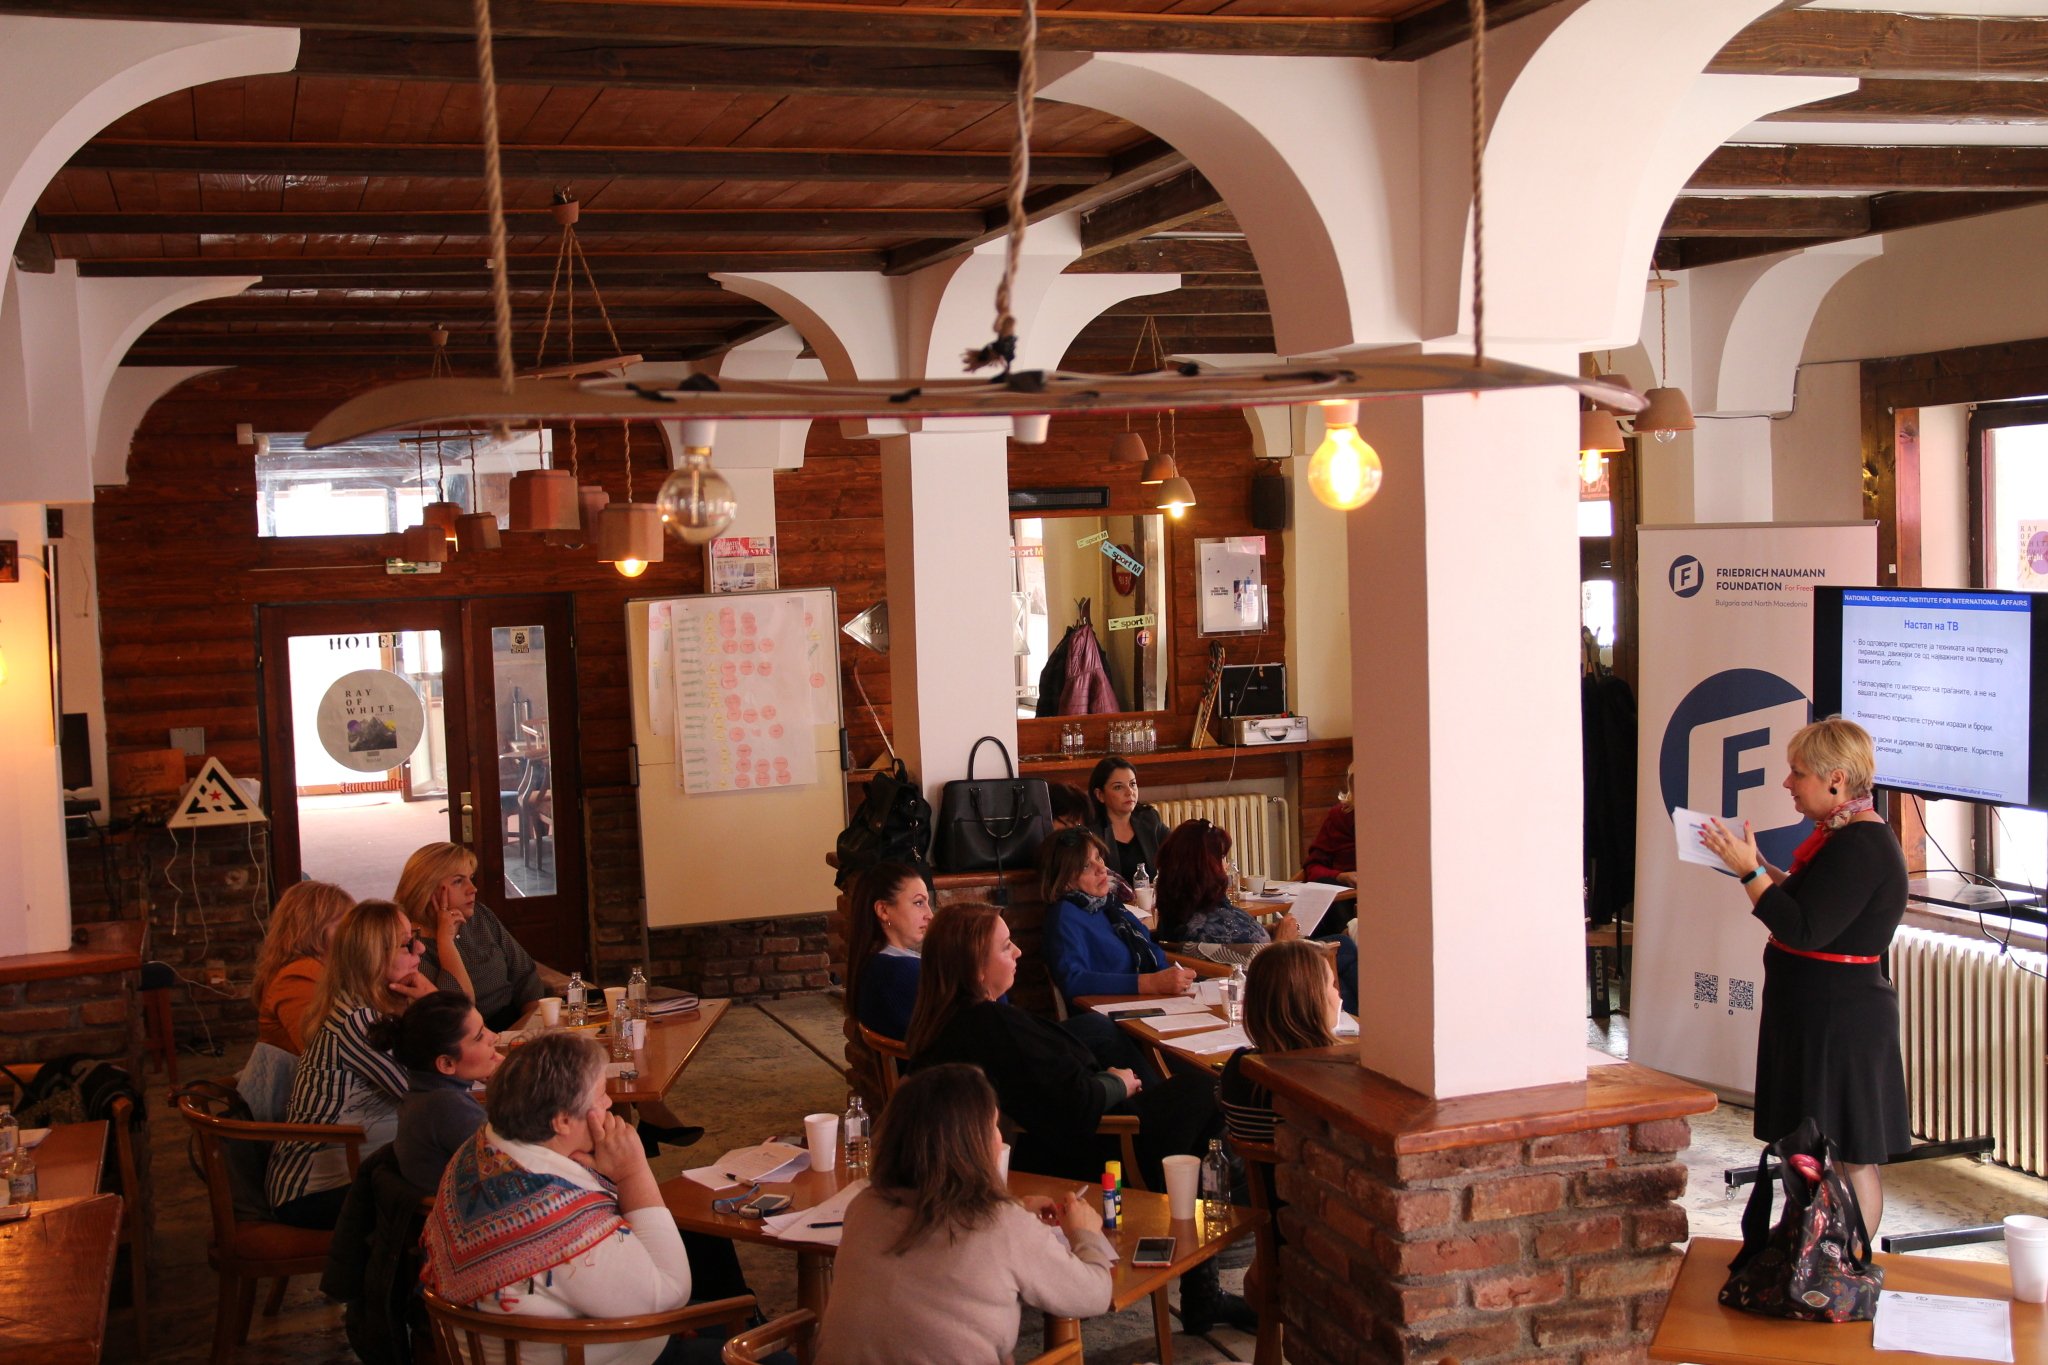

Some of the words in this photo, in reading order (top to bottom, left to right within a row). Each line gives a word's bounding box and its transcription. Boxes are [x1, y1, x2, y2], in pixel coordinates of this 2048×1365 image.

[1111, 550, 1133, 569] sport
[1132, 563, 1141, 574] M
[1716, 568, 1769, 578] FRIEDRICH
[1771, 568, 1826, 578] NAUMANN
[1716, 581, 1782, 591] FOUNDATION
[1715, 599, 1740, 608] Bulgaria
[1741, 599, 1752, 607] and
[1773, 600, 1808, 608] Macedonia
[1844, 594, 1871, 602] NATIONAL
[1871, 595, 1908, 603] DEMOCRATIC
[1909, 596, 1938, 604] INSTITUTE
[1952, 598, 1999, 606] INTERNATIONAL
[2000, 599, 2028, 607] AFFAIRS
[1121, 617, 1144, 630] sport
[1144, 615, 1154, 625] M
[1904, 620, 1932, 631] Настап
[1934, 623, 1945, 631] на
[1947, 621, 1959, 631] ТВ
[330, 633, 404, 650] HOTEL
[1857, 638, 1866, 646] Во
[345, 689, 371, 698] RAY
[345, 698, 362, 706] OF
[346, 704, 394, 715] WHITE
[1857, 710, 1891, 721] Внимателно
[1971, 746, 2004, 757] Користете
